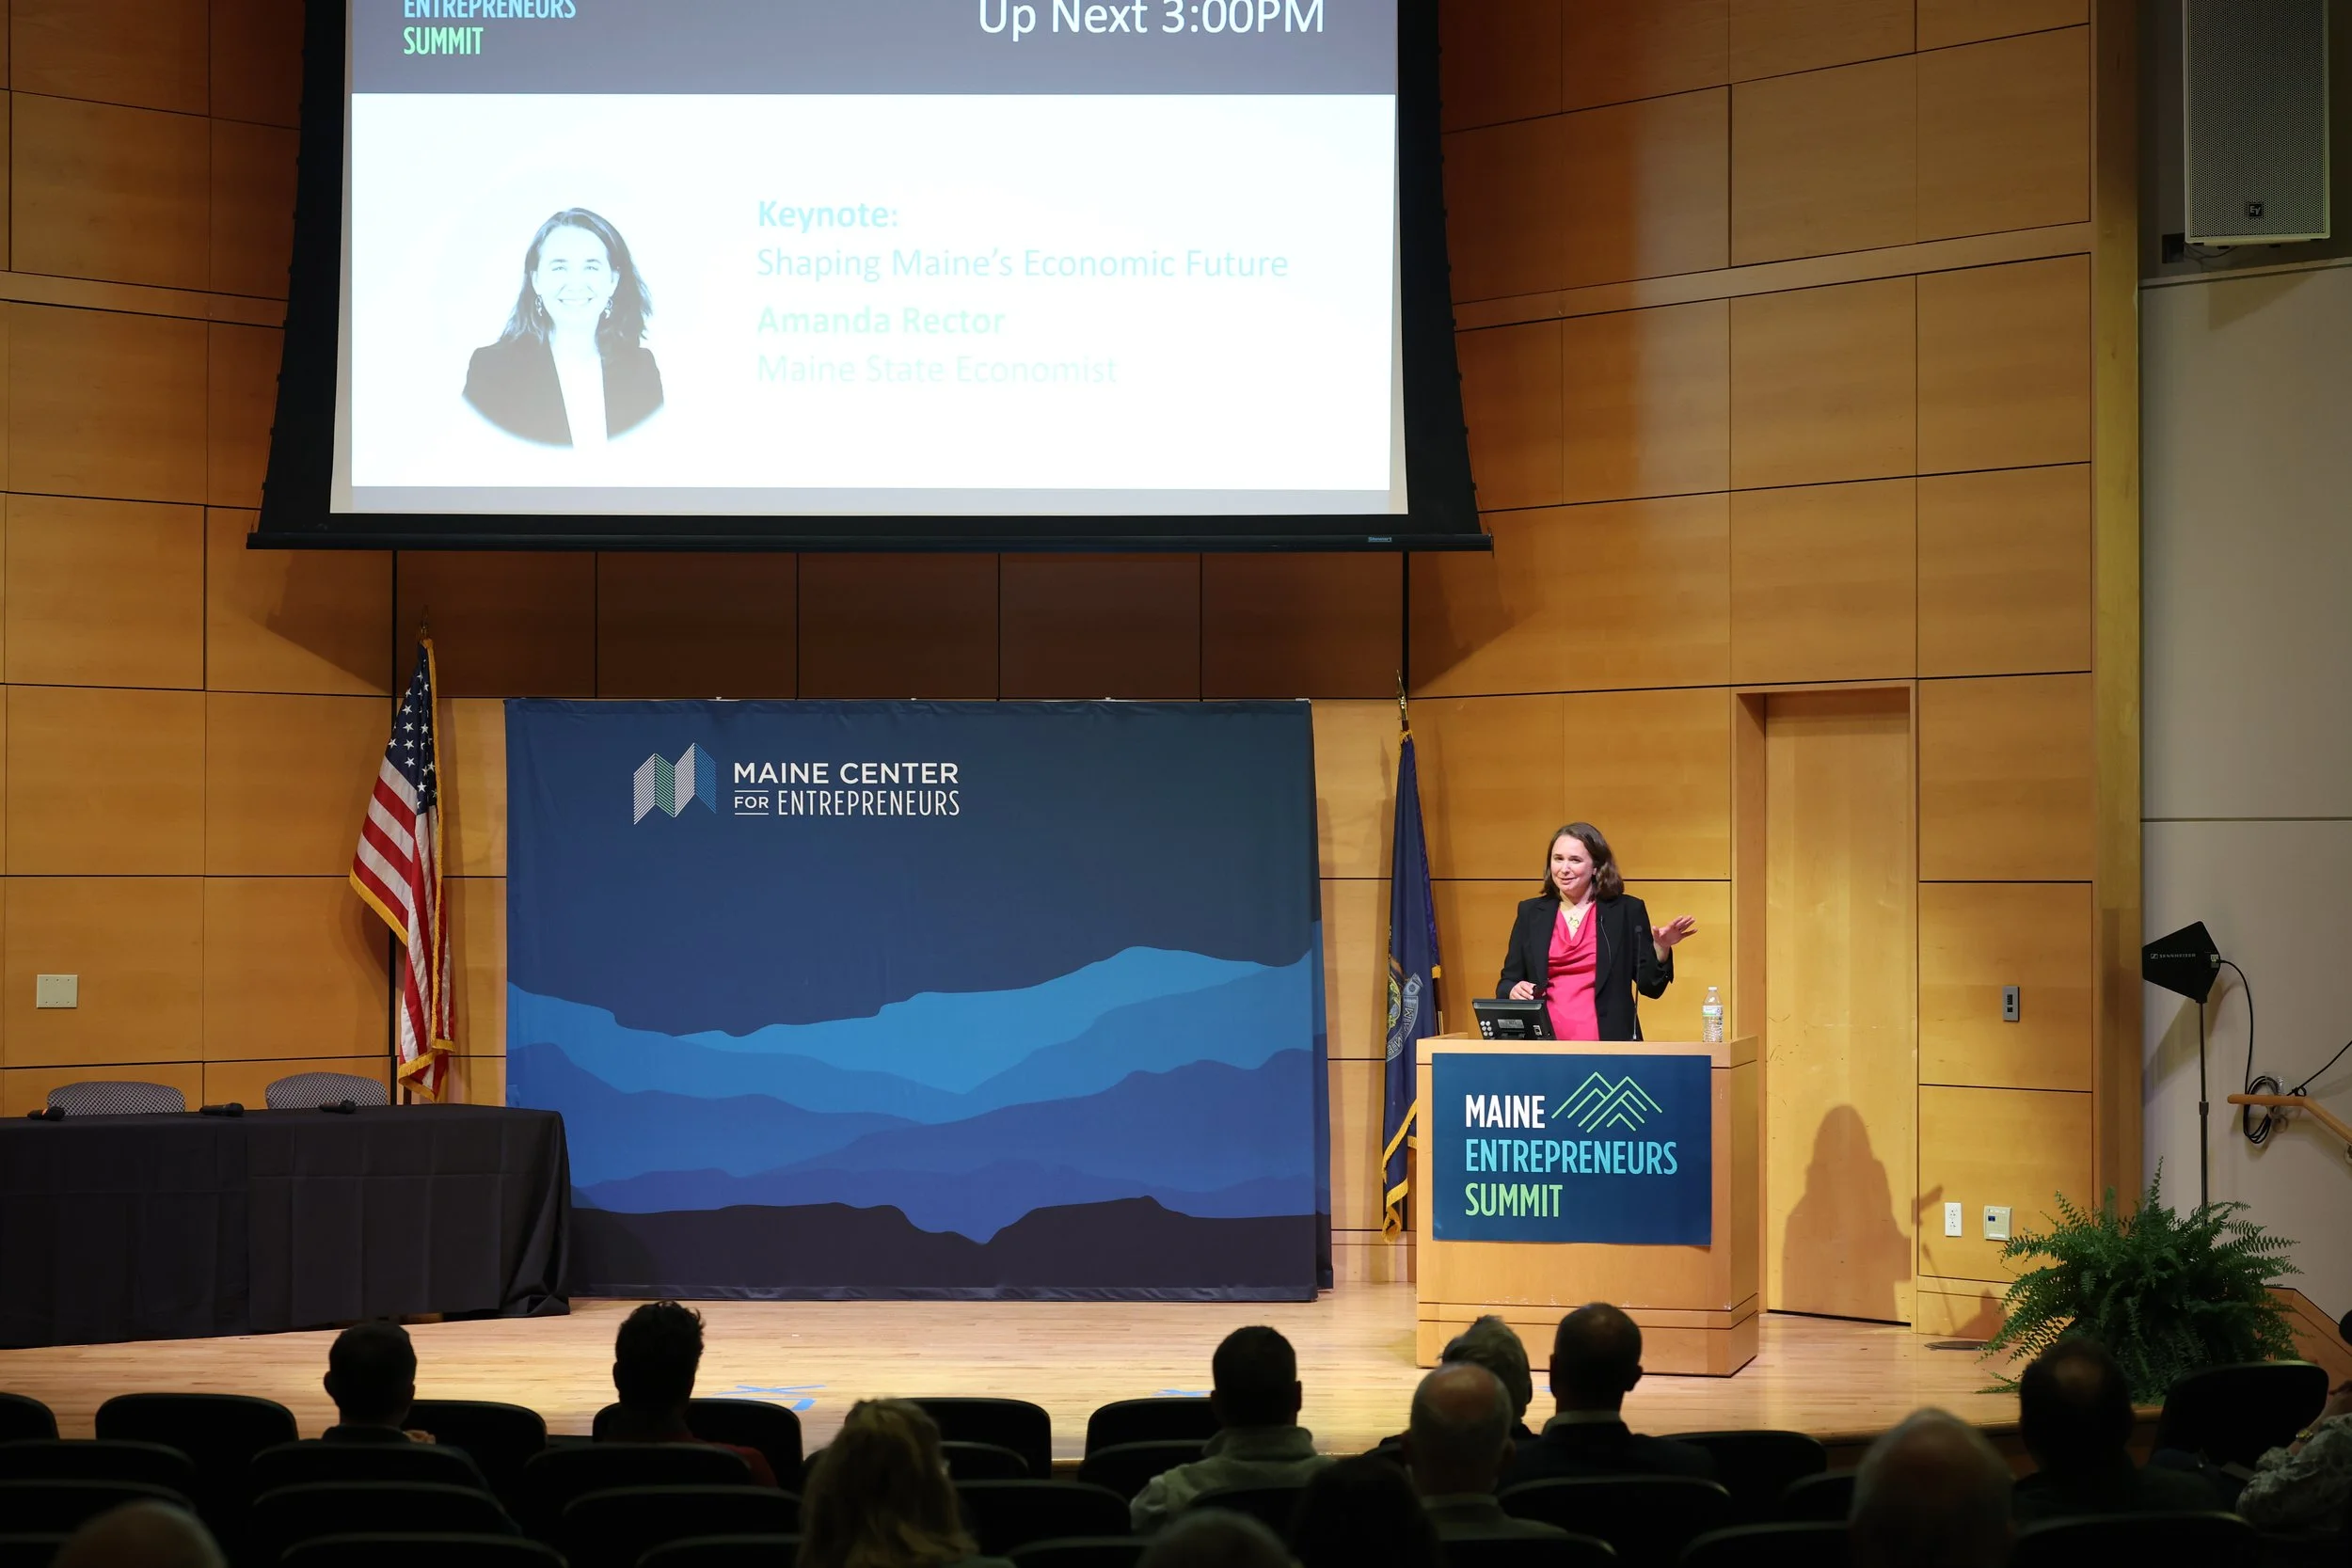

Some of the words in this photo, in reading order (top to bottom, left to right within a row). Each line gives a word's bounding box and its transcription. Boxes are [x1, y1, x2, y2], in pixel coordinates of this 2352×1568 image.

[404, 0, 577, 19] ENTREPRENEURS
[979, 0, 1037, 41] Up
[1052, 0, 1149, 33] Next
[1162, 0, 1325, 32] 3:00PM
[403, 26, 485, 55] SUMMIT
[758, 200, 898, 233] Keynote:
[756, 247, 882, 282] Shaping
[1025, 249, 1176, 277] Economic
[1186, 249, 1289, 277] Future
[756, 305, 891, 335] Amanda
[901, 307, 1007, 335] Rector
[756, 354, 856, 383] Maine
[866, 354, 946, 383] State
[957, 356, 1118, 383] Economist
[734, 763, 829, 784] MAINE
[839, 763, 959, 784] CENTER
[734, 797, 769, 809] FOR
[778, 790, 960, 816] ENTREPRENEURS
[1465, 1094, 1546, 1129] MAINE
[1466, 1138, 1678, 1176] ENTREPRENEURS
[1465, 1182, 1564, 1218] SUMMIT
